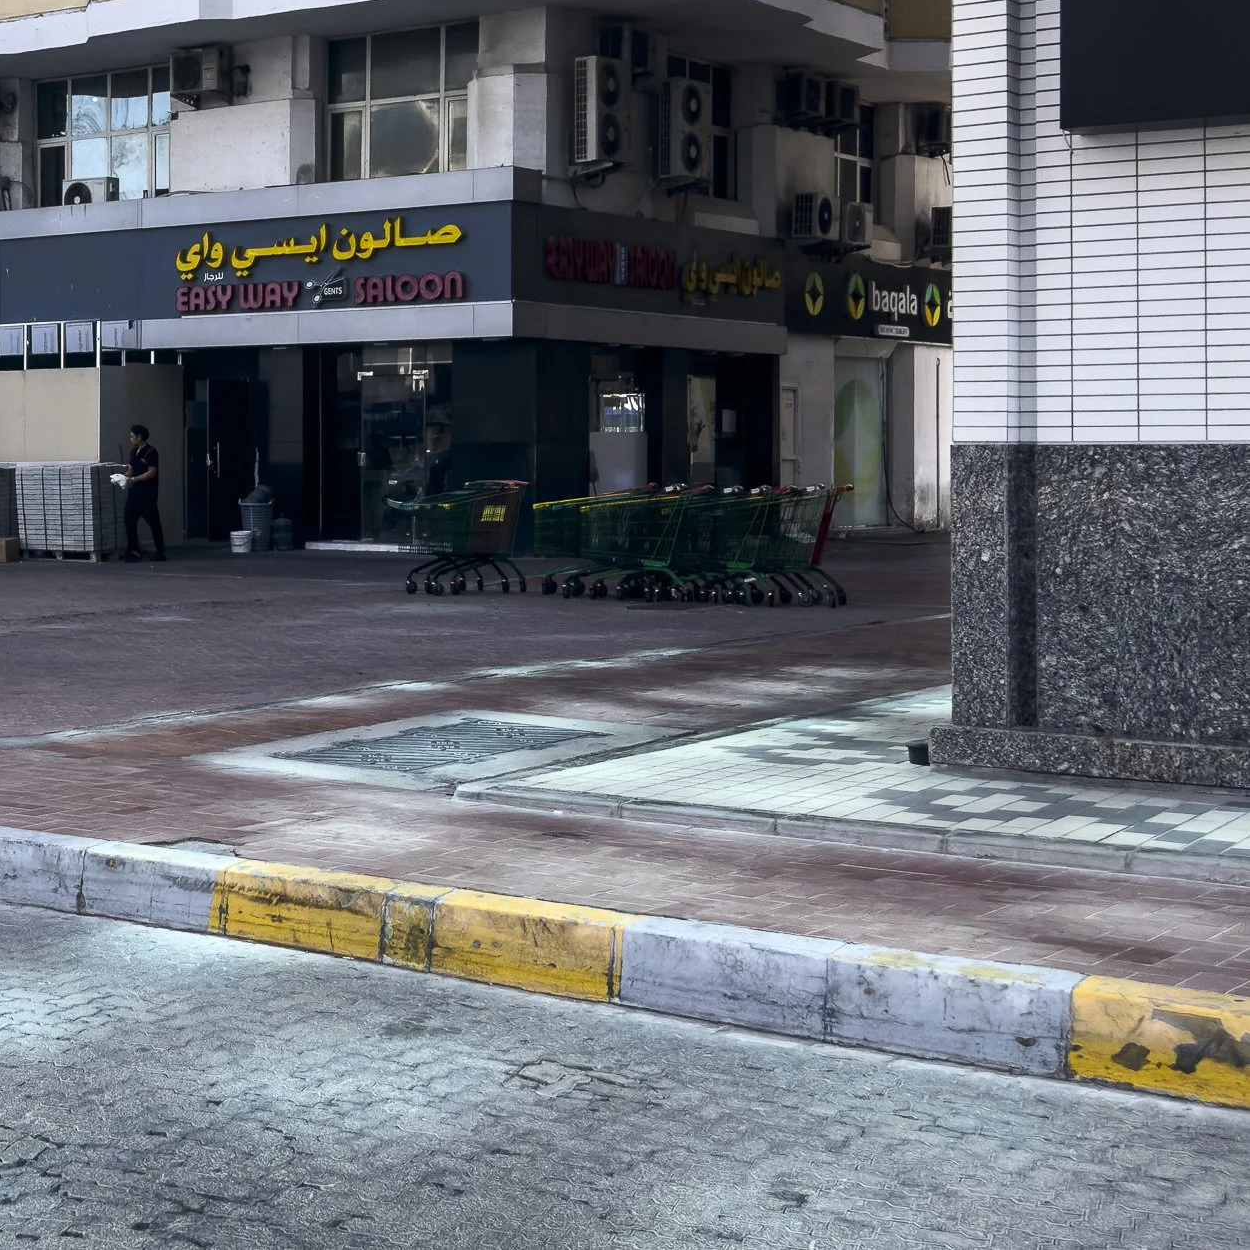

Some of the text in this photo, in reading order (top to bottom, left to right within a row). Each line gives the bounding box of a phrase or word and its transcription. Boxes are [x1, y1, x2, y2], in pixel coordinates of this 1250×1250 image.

[175, 217, 462, 280] صالون ايسي واي
[175, 280, 299, 312] EASY WAY
[323, 286, 343, 297] GENTS
[354, 269, 463, 305] SALOON
[871, 280, 918, 321] baqala
